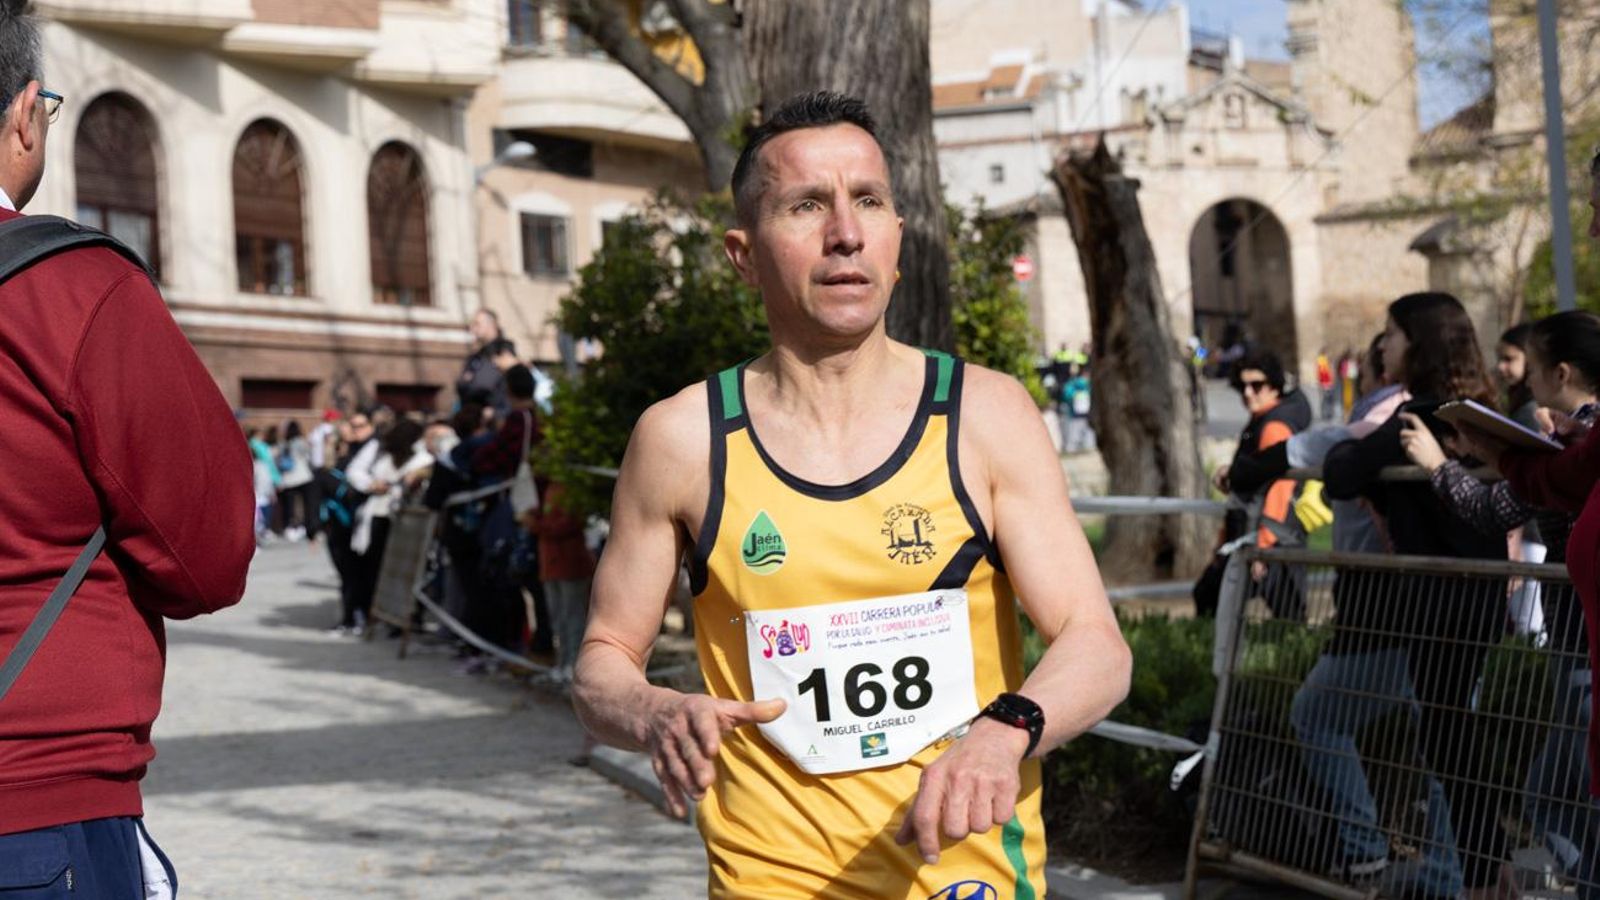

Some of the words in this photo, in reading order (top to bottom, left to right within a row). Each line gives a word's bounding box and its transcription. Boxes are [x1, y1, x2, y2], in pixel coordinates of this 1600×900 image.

[743, 532, 781, 557] Jaén
[860, 605, 901, 622] CARRERA
[798, 656, 933, 722] 168
[823, 724, 863, 737] MIGUEL
[867, 714, 916, 732] CARRILLO
